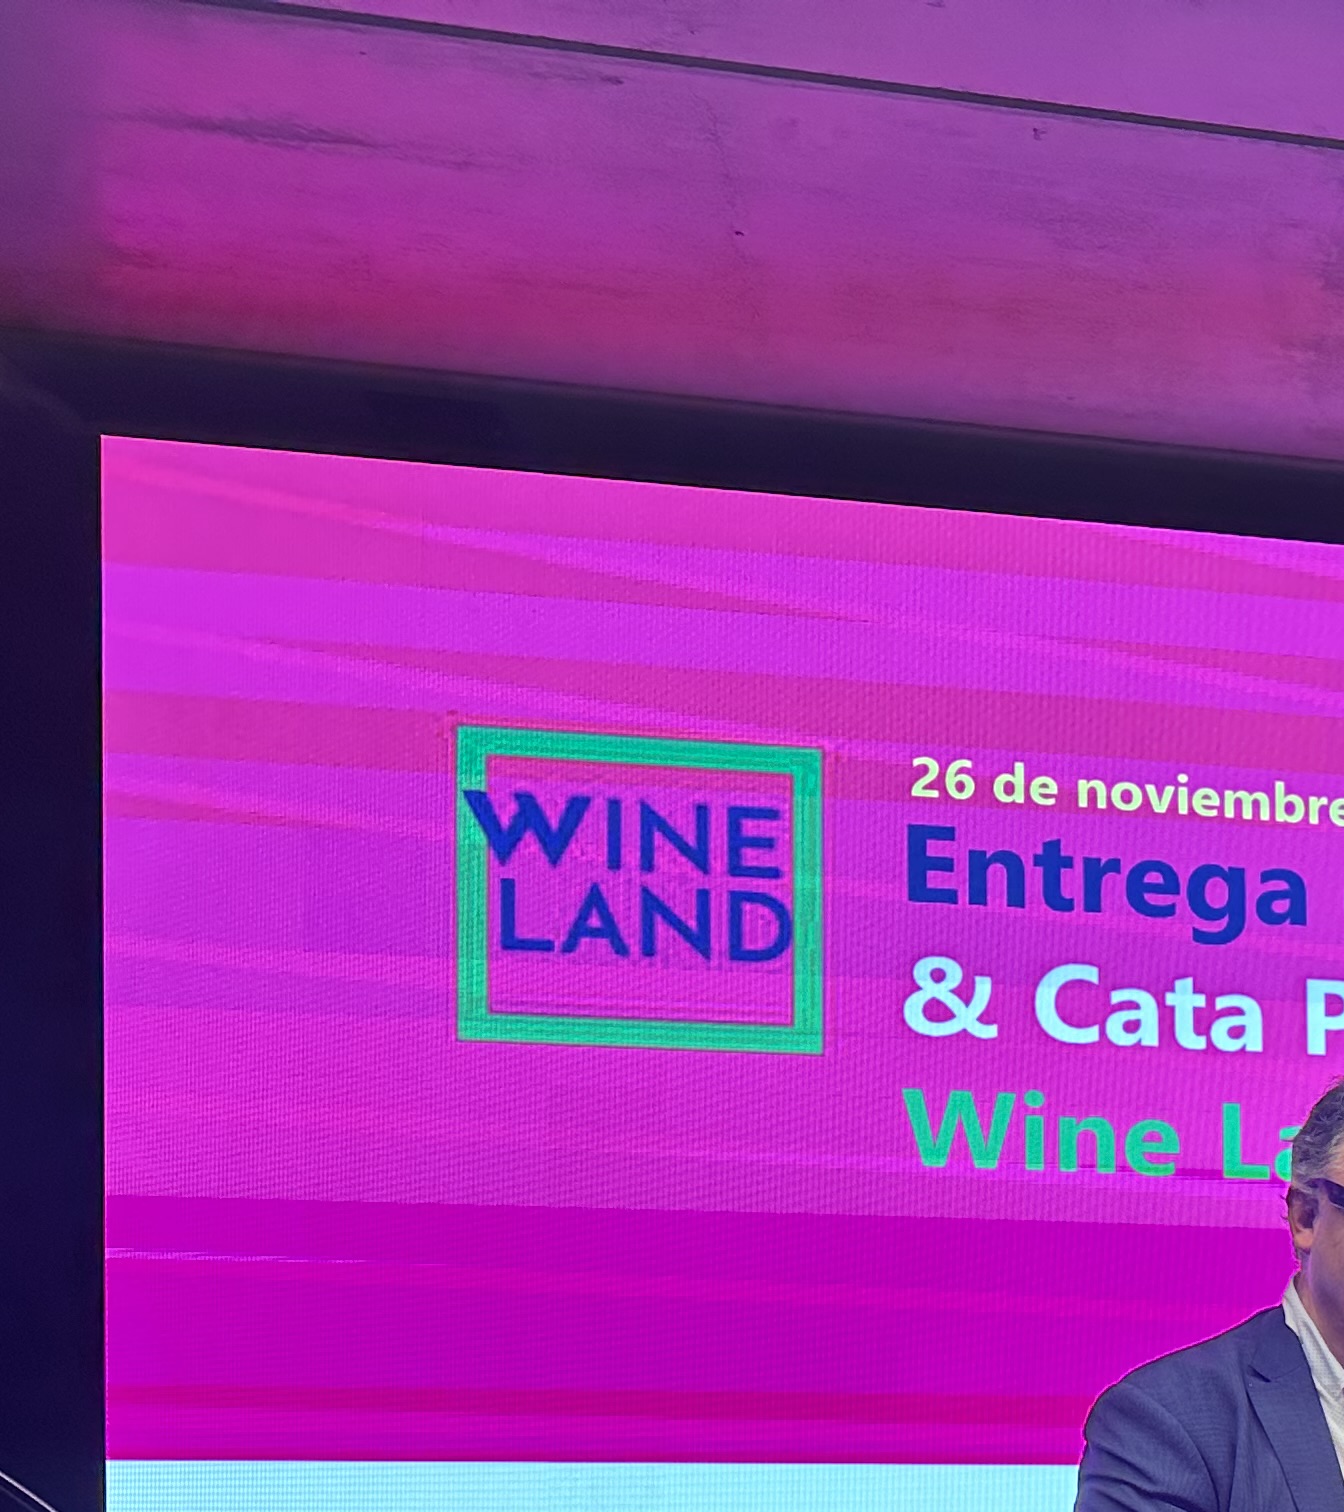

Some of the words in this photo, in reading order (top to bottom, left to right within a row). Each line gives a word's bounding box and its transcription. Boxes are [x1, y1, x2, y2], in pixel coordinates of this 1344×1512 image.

[910, 757, 975, 800] 26
[993, 763, 1058, 806] de
[463, 790, 782, 879] WINE
[500, 877, 792, 962] LAND
[906, 823, 1308, 945] Entrega
[902, 955, 998, 1040] &
[1034, 963, 1264, 1054] Cata
[902, 1087, 1180, 1178] Wine
